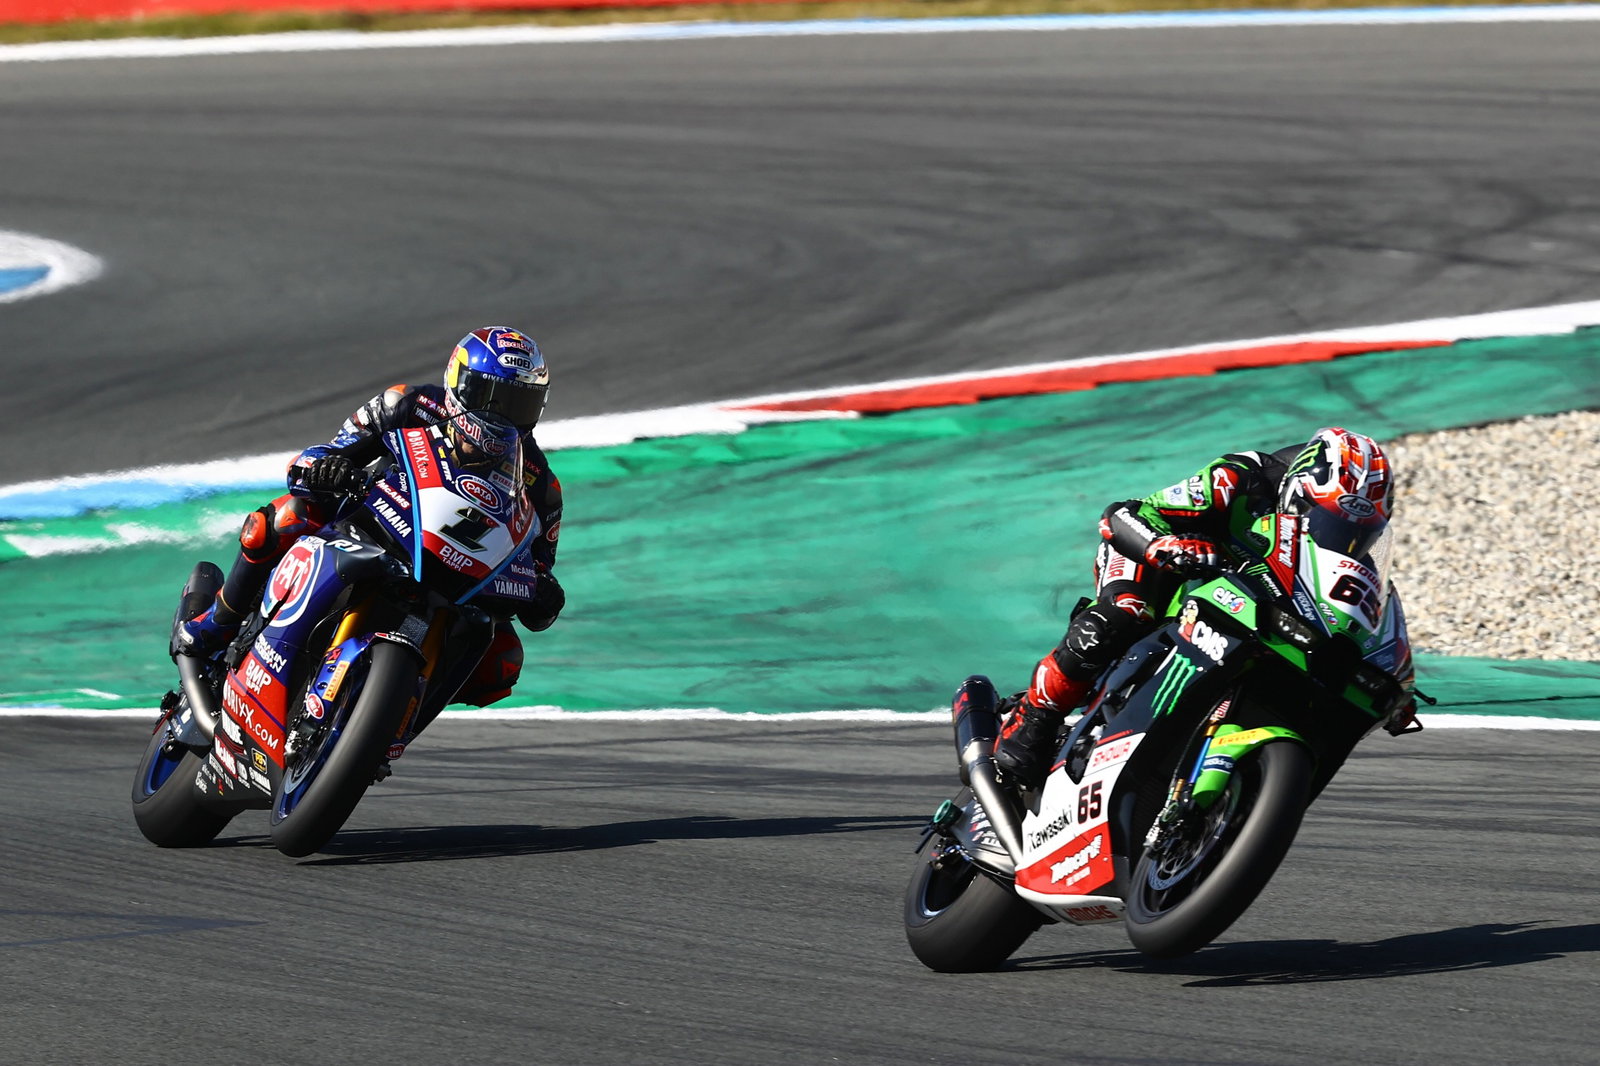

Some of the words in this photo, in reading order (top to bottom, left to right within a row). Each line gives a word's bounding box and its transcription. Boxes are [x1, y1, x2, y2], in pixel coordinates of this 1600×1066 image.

[505, 356, 531, 369] SHOEI
[457, 414, 481, 441] Bull
[466, 482, 493, 501] PATA
[1341, 497, 1373, 514] Arai
[372, 496, 412, 538] YAMAHA
[439, 544, 473, 567] BMP
[442, 556, 462, 571] TAPPI
[494, 579, 530, 598] YAMAHA
[1213, 587, 1238, 606] elf
[246, 658, 272, 688] BMP
[1078, 780, 1103, 825] 65
[1029, 804, 1073, 852] Kawasaki
